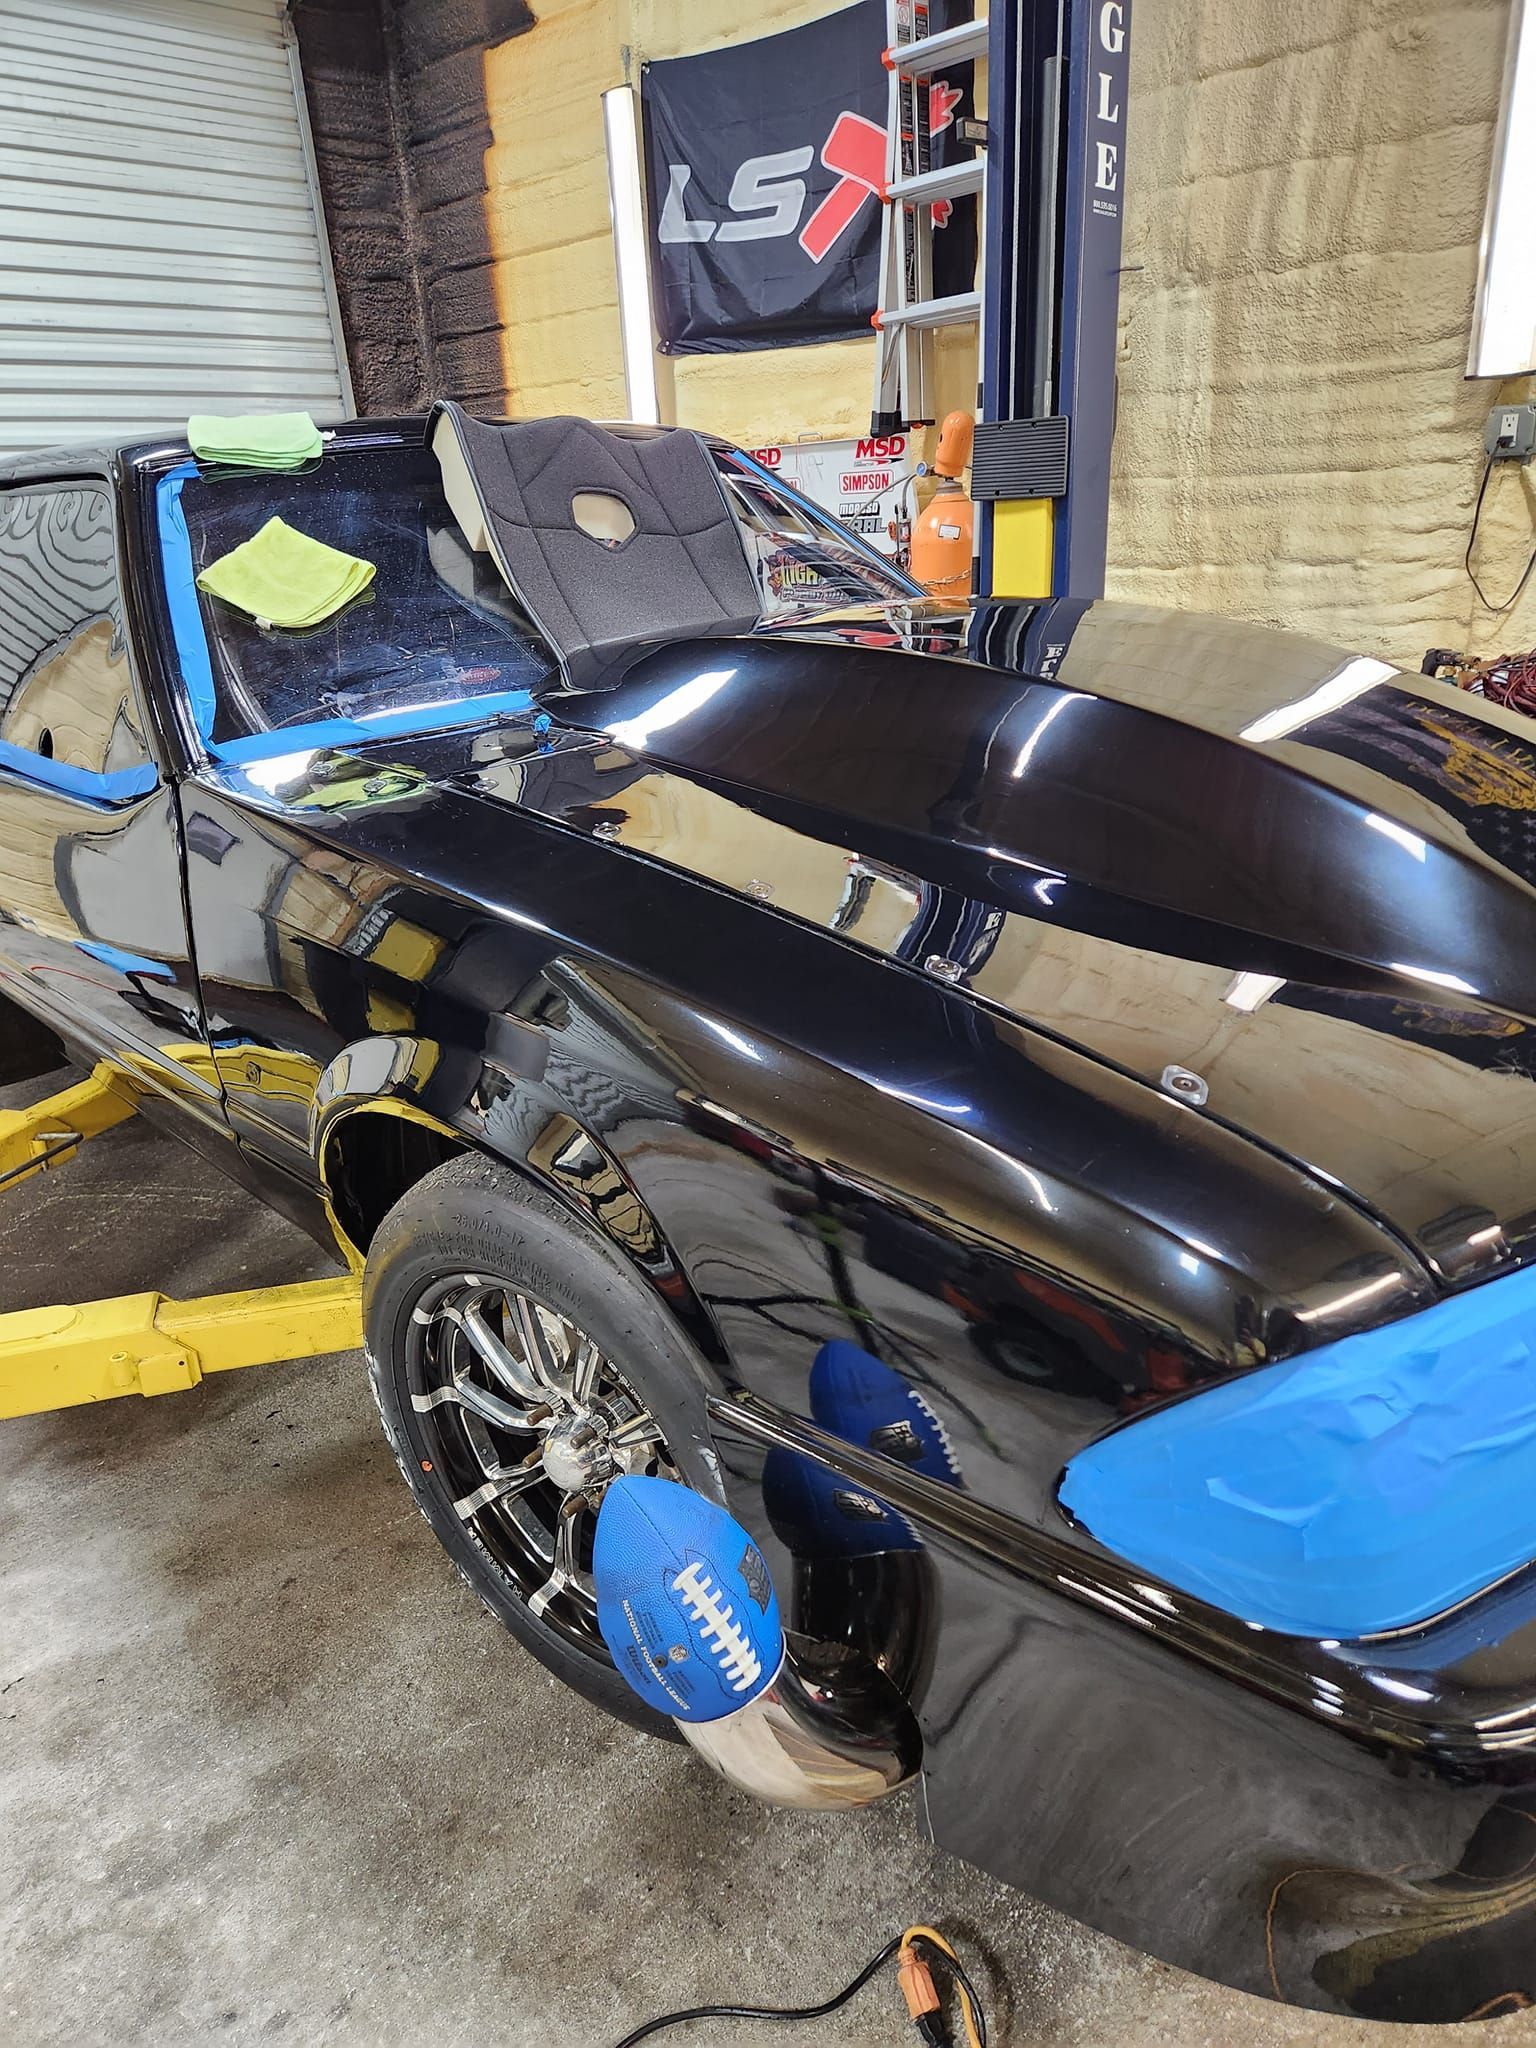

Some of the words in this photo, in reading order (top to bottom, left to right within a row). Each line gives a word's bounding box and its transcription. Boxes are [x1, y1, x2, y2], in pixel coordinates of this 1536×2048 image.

[855, 436, 906, 459] MSD
[842, 473, 889, 491] SIMPSON
[622, 1599, 643, 1645] NATIONAL
[640, 1646, 667, 1687] FOOTBALL
[665, 1686, 691, 1711] LEAGUE
